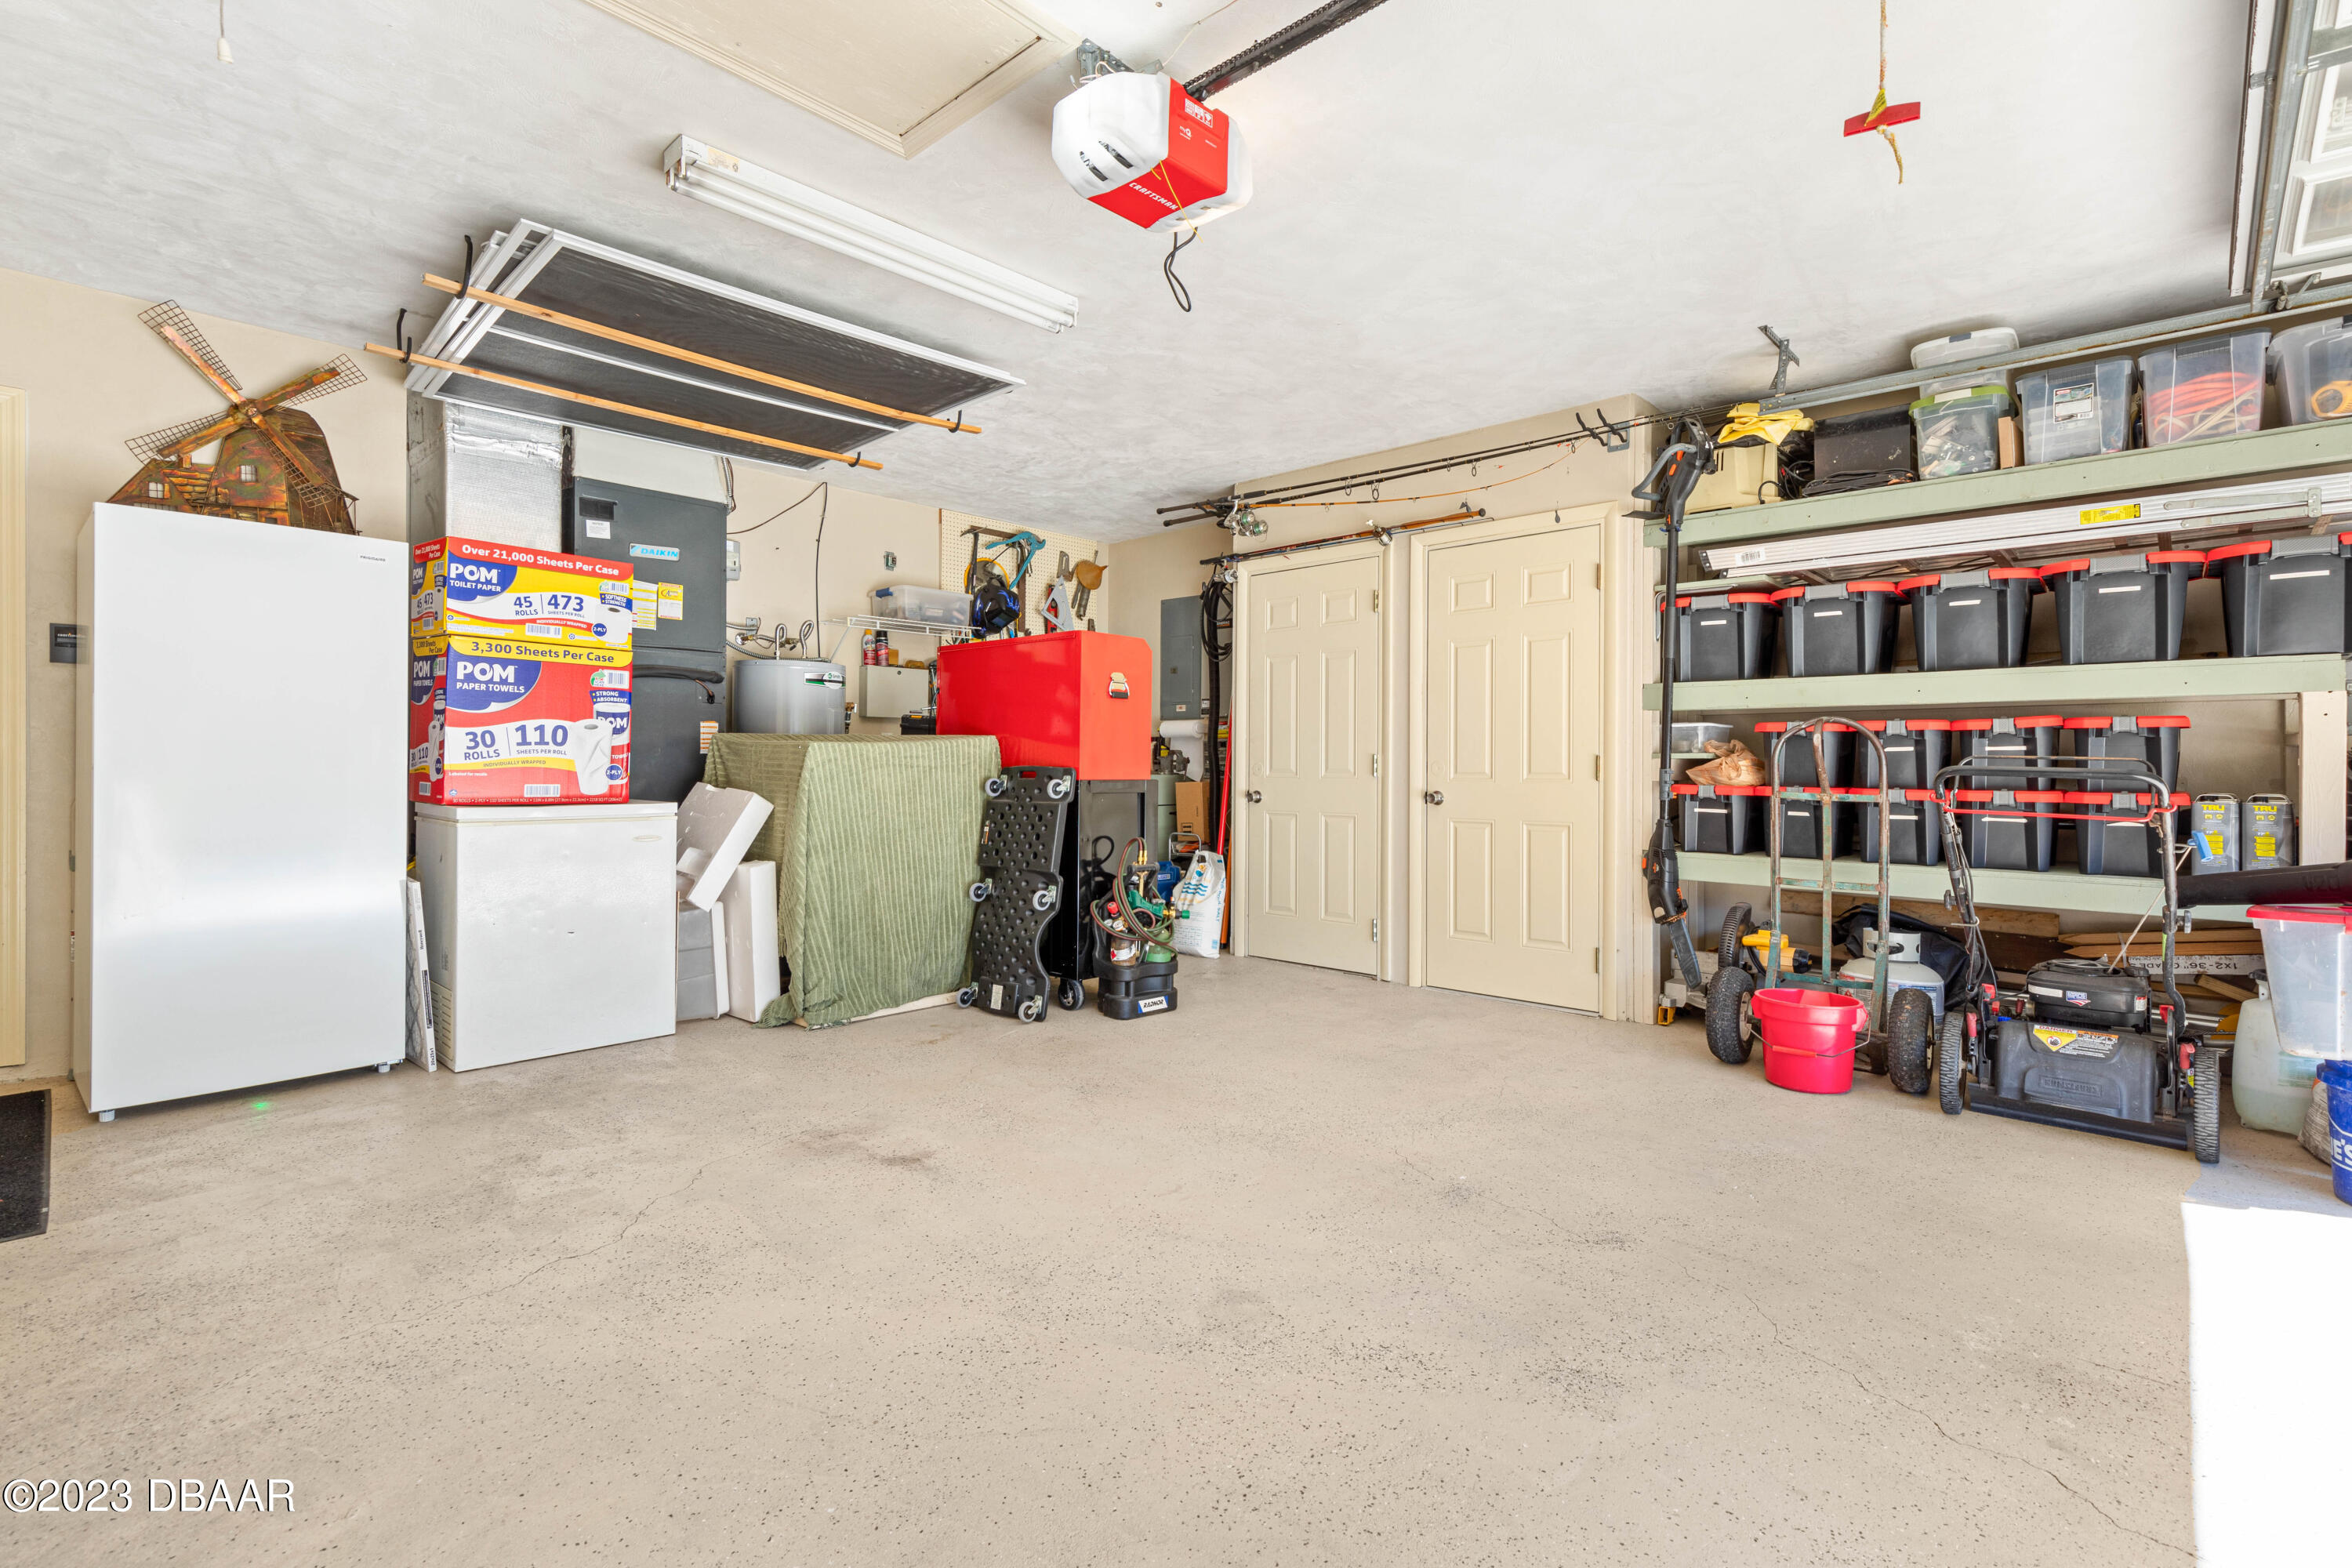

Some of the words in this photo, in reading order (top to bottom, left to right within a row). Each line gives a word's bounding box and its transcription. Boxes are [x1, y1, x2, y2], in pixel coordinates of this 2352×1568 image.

[1129, 183, 1178, 210] CRAFTSMAN
[641, 548, 678, 557] DAIKIN
[462, 545, 490, 557] Over
[492, 549, 534, 562] 21,000
[536, 556, 573, 569] Sheets
[575, 561, 593, 572] Per
[595, 564, 619, 575] Case
[412, 567, 423, 579] POM
[450, 563, 498, 583] POM
[450, 580, 477, 589] TOILET
[477, 583, 501, 592] PAPER
[417, 598, 423, 608] 45
[424, 593, 433, 605] 473
[514, 596, 533, 608] 45
[547, 594, 584, 612] 473
[604, 593, 627, 602] SOFTNESS
[471, 641, 512, 654] 3,300
[516, 646, 560, 658] Sheets
[563, 650, 583, 659] Per
[586, 652, 614, 662] Case
[413, 660, 430, 678] POM
[456, 661, 515, 683] POM
[456, 682, 486, 691] PAPER
[488, 684, 524, 693] TOWELS
[465, 729, 496, 750] 30
[514, 724, 568, 746] 110
[411, 753, 416, 762] 30
[418, 746, 429, 760] 110
[464, 749, 500, 760] ROLLS
[1144, 1000, 1164, 1008] RADNOR
